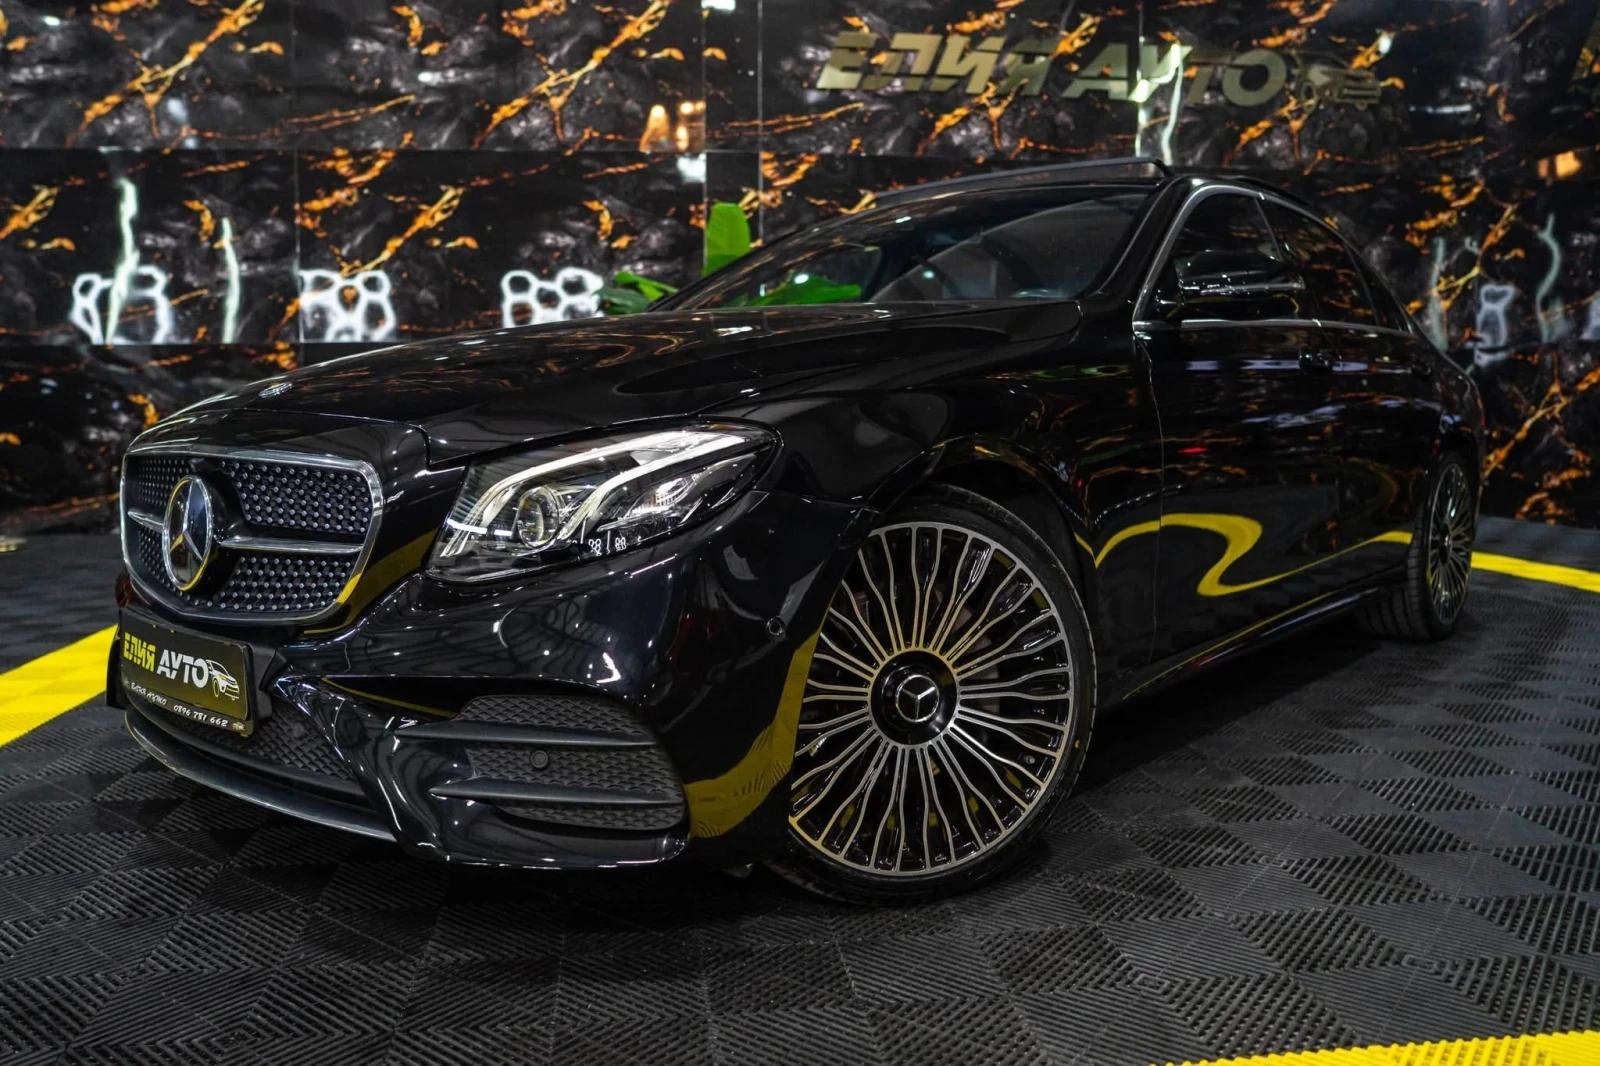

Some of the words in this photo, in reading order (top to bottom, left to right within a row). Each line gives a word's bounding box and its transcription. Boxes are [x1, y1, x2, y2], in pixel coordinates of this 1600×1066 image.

[123, 632, 157, 673] ЕЛИЯ
[173, 705, 191, 717] 0896
[193, 711, 208, 721] 781
[210, 716, 229, 727] 662
